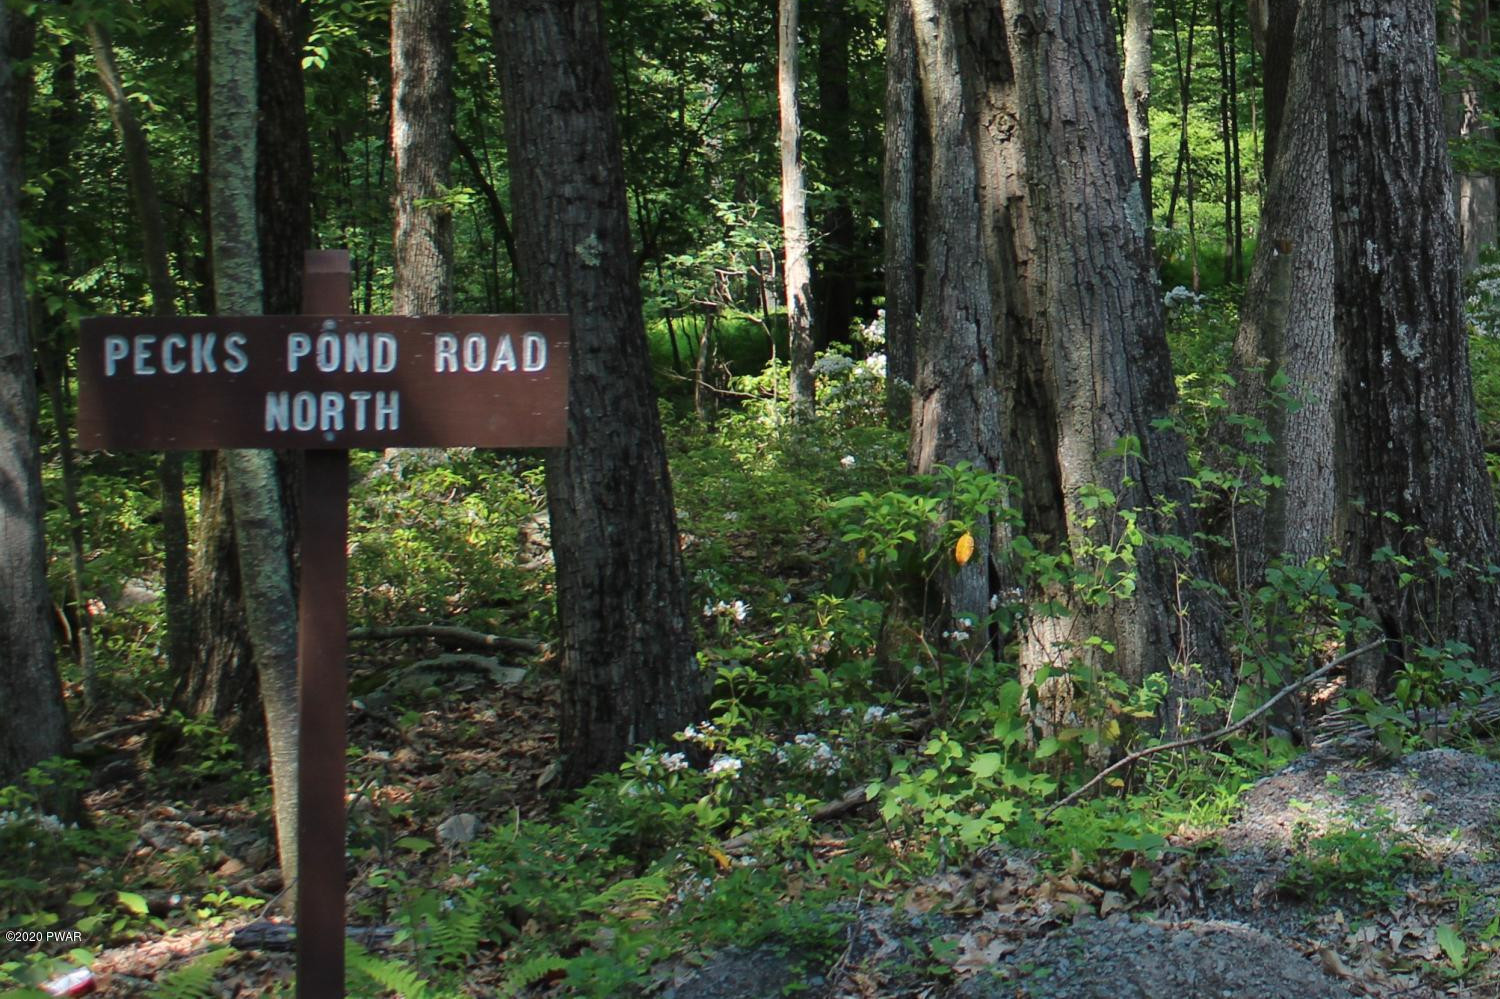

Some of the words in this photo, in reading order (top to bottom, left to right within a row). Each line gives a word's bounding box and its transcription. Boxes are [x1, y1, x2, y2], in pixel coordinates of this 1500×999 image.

[103, 332, 249, 377] PECKS
[286, 331, 399, 374] POND
[434, 331, 548, 373] ROAD
[264, 390, 400, 433] NORTH
